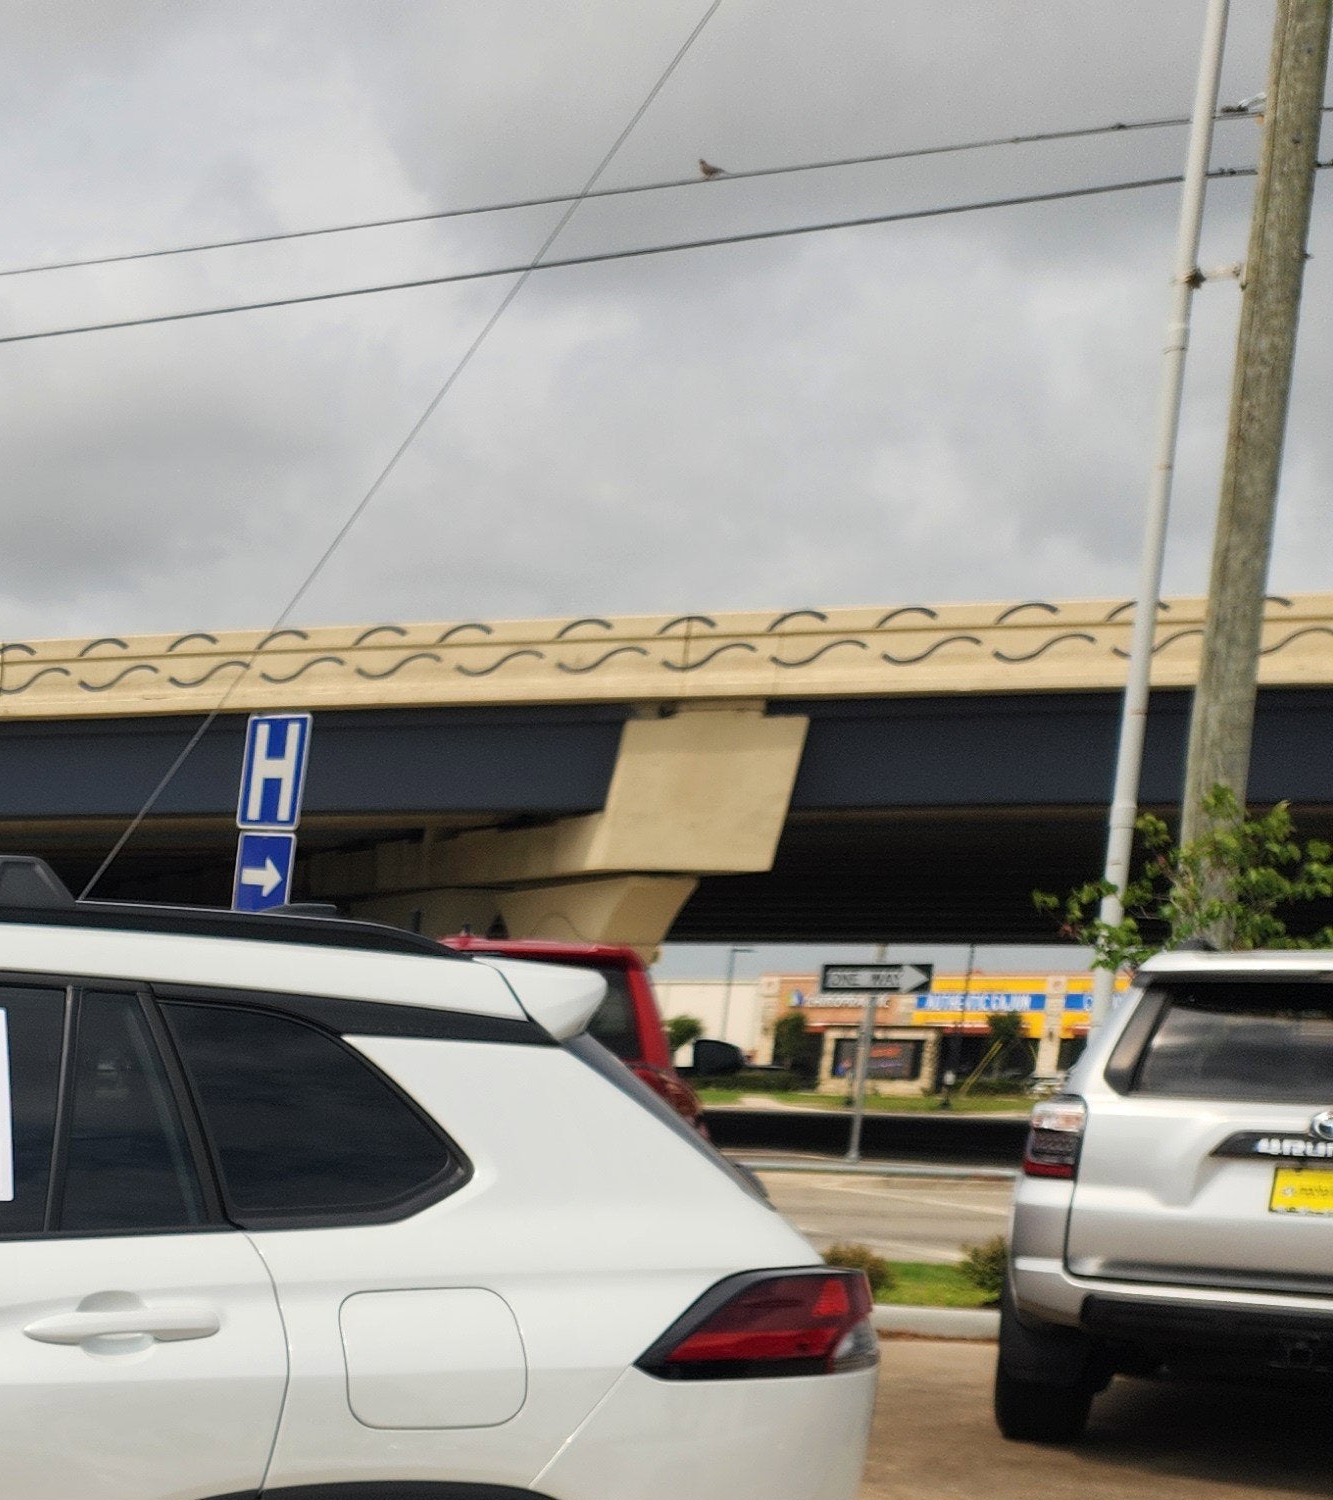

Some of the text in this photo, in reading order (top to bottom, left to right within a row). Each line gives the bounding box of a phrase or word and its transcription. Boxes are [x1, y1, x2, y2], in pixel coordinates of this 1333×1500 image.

[247, 722, 301, 822] H
[832, 973, 901, 987] ONE WAY
